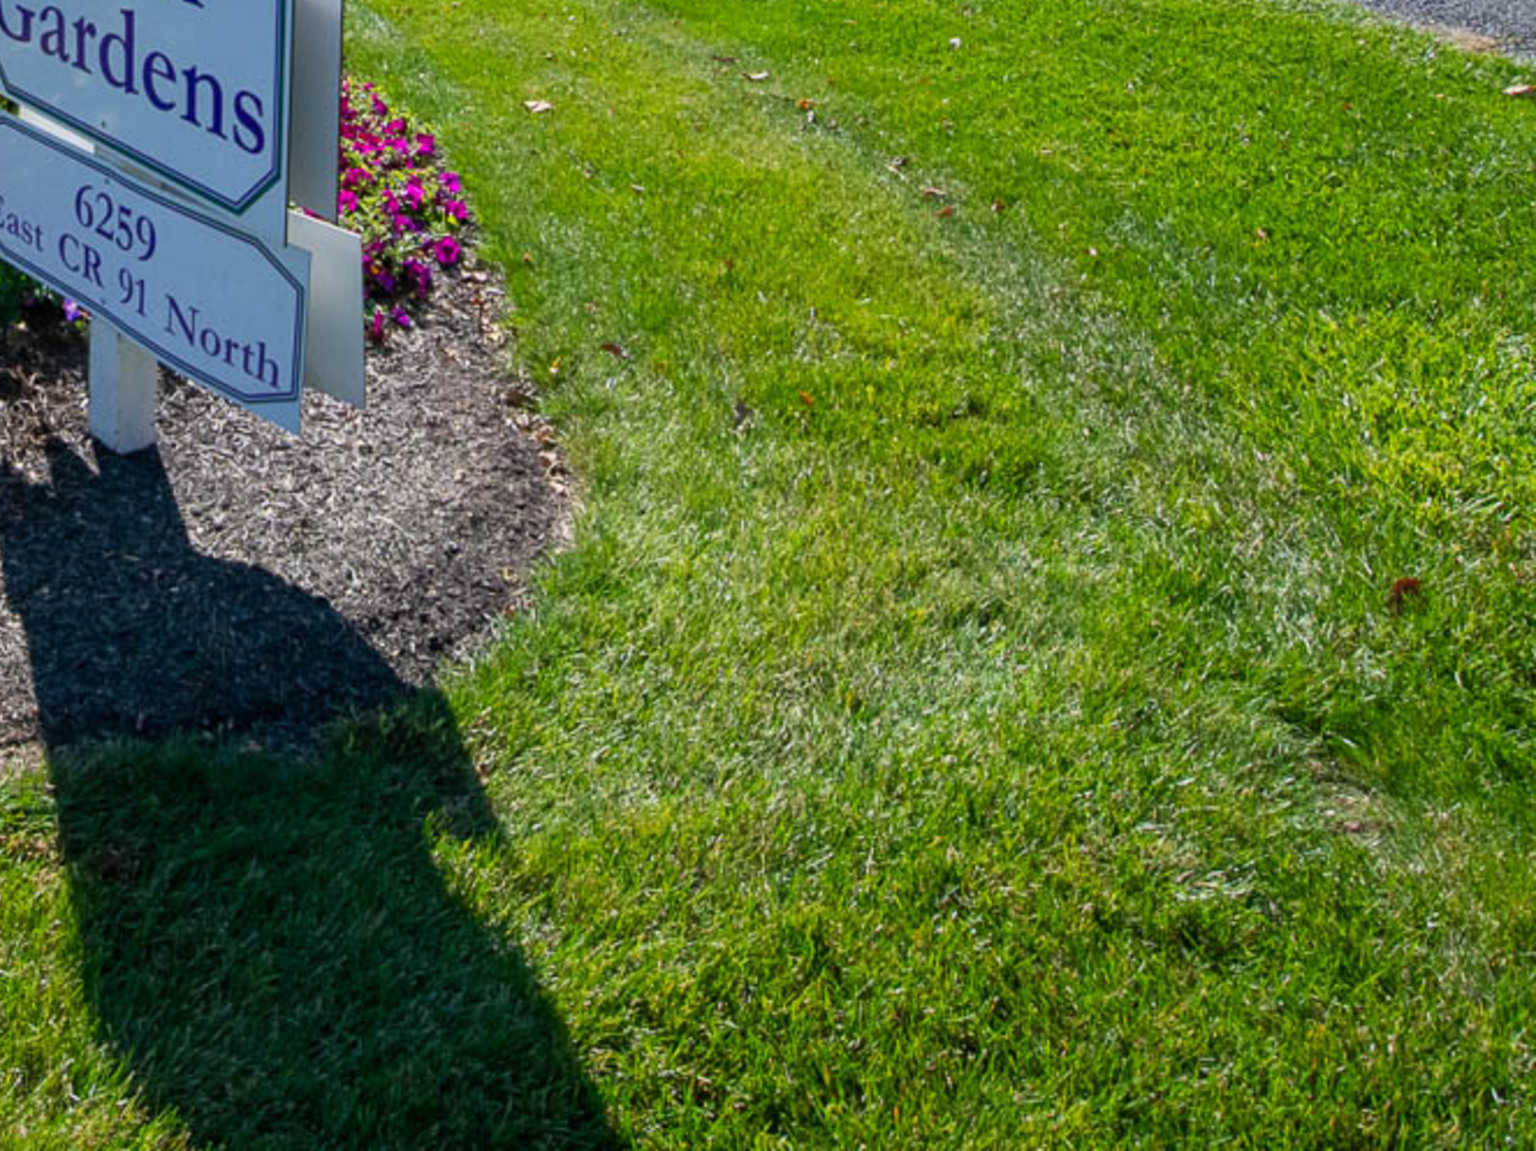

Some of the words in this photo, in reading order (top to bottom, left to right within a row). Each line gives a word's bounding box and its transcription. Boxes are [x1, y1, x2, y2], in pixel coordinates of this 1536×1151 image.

[75, 185, 157, 262] 6259
[59, 234, 104, 287] CR
[119, 268, 147, 316] 91
[165, 295, 280, 389] North
